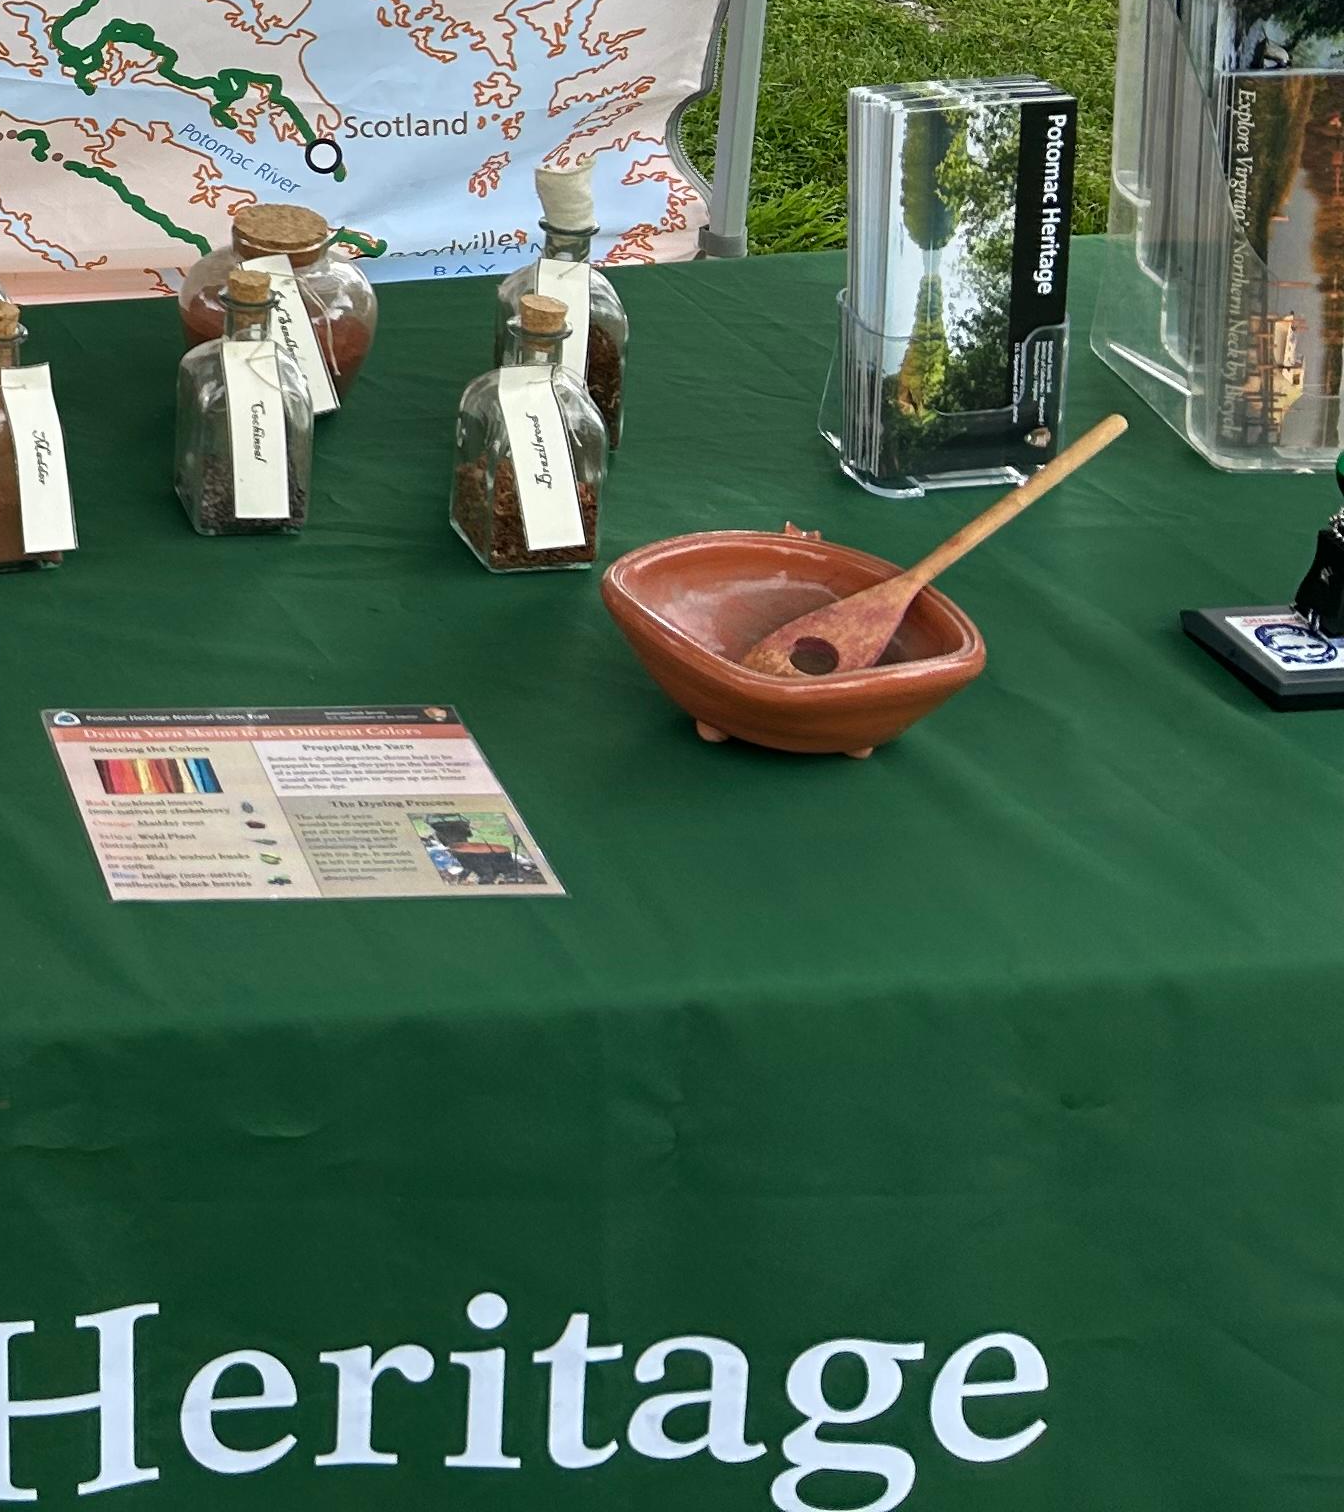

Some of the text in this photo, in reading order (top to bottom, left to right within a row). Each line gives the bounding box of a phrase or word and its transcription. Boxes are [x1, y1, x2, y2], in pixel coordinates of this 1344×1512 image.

[344, 111, 467, 138] Scotland
[1234, 89, 1257, 151] Explore
[178, 122, 300, 195] Potomac River
[1033, 114, 1068, 295] Potomac Heritage
[433, 263, 496, 276] BAY
[1229, 240, 1248, 315] Northern
[1227, 319, 1247, 358] Neck
[1220, 360, 1246, 381] by
[250, 400, 267, 464] Cochineal
[1219, 384, 1244, 439] Bicycle
[32, 430, 52, 485] Madder
[526, 412, 552, 489] Brazilwood
[83, 726, 422, 740] Dyeing Yarn Skeins to get Different Colors
[301, 743, 361, 753] Prepping
[361, 743, 382, 751] the
[331, 799, 456, 809] The Dyeing Process
